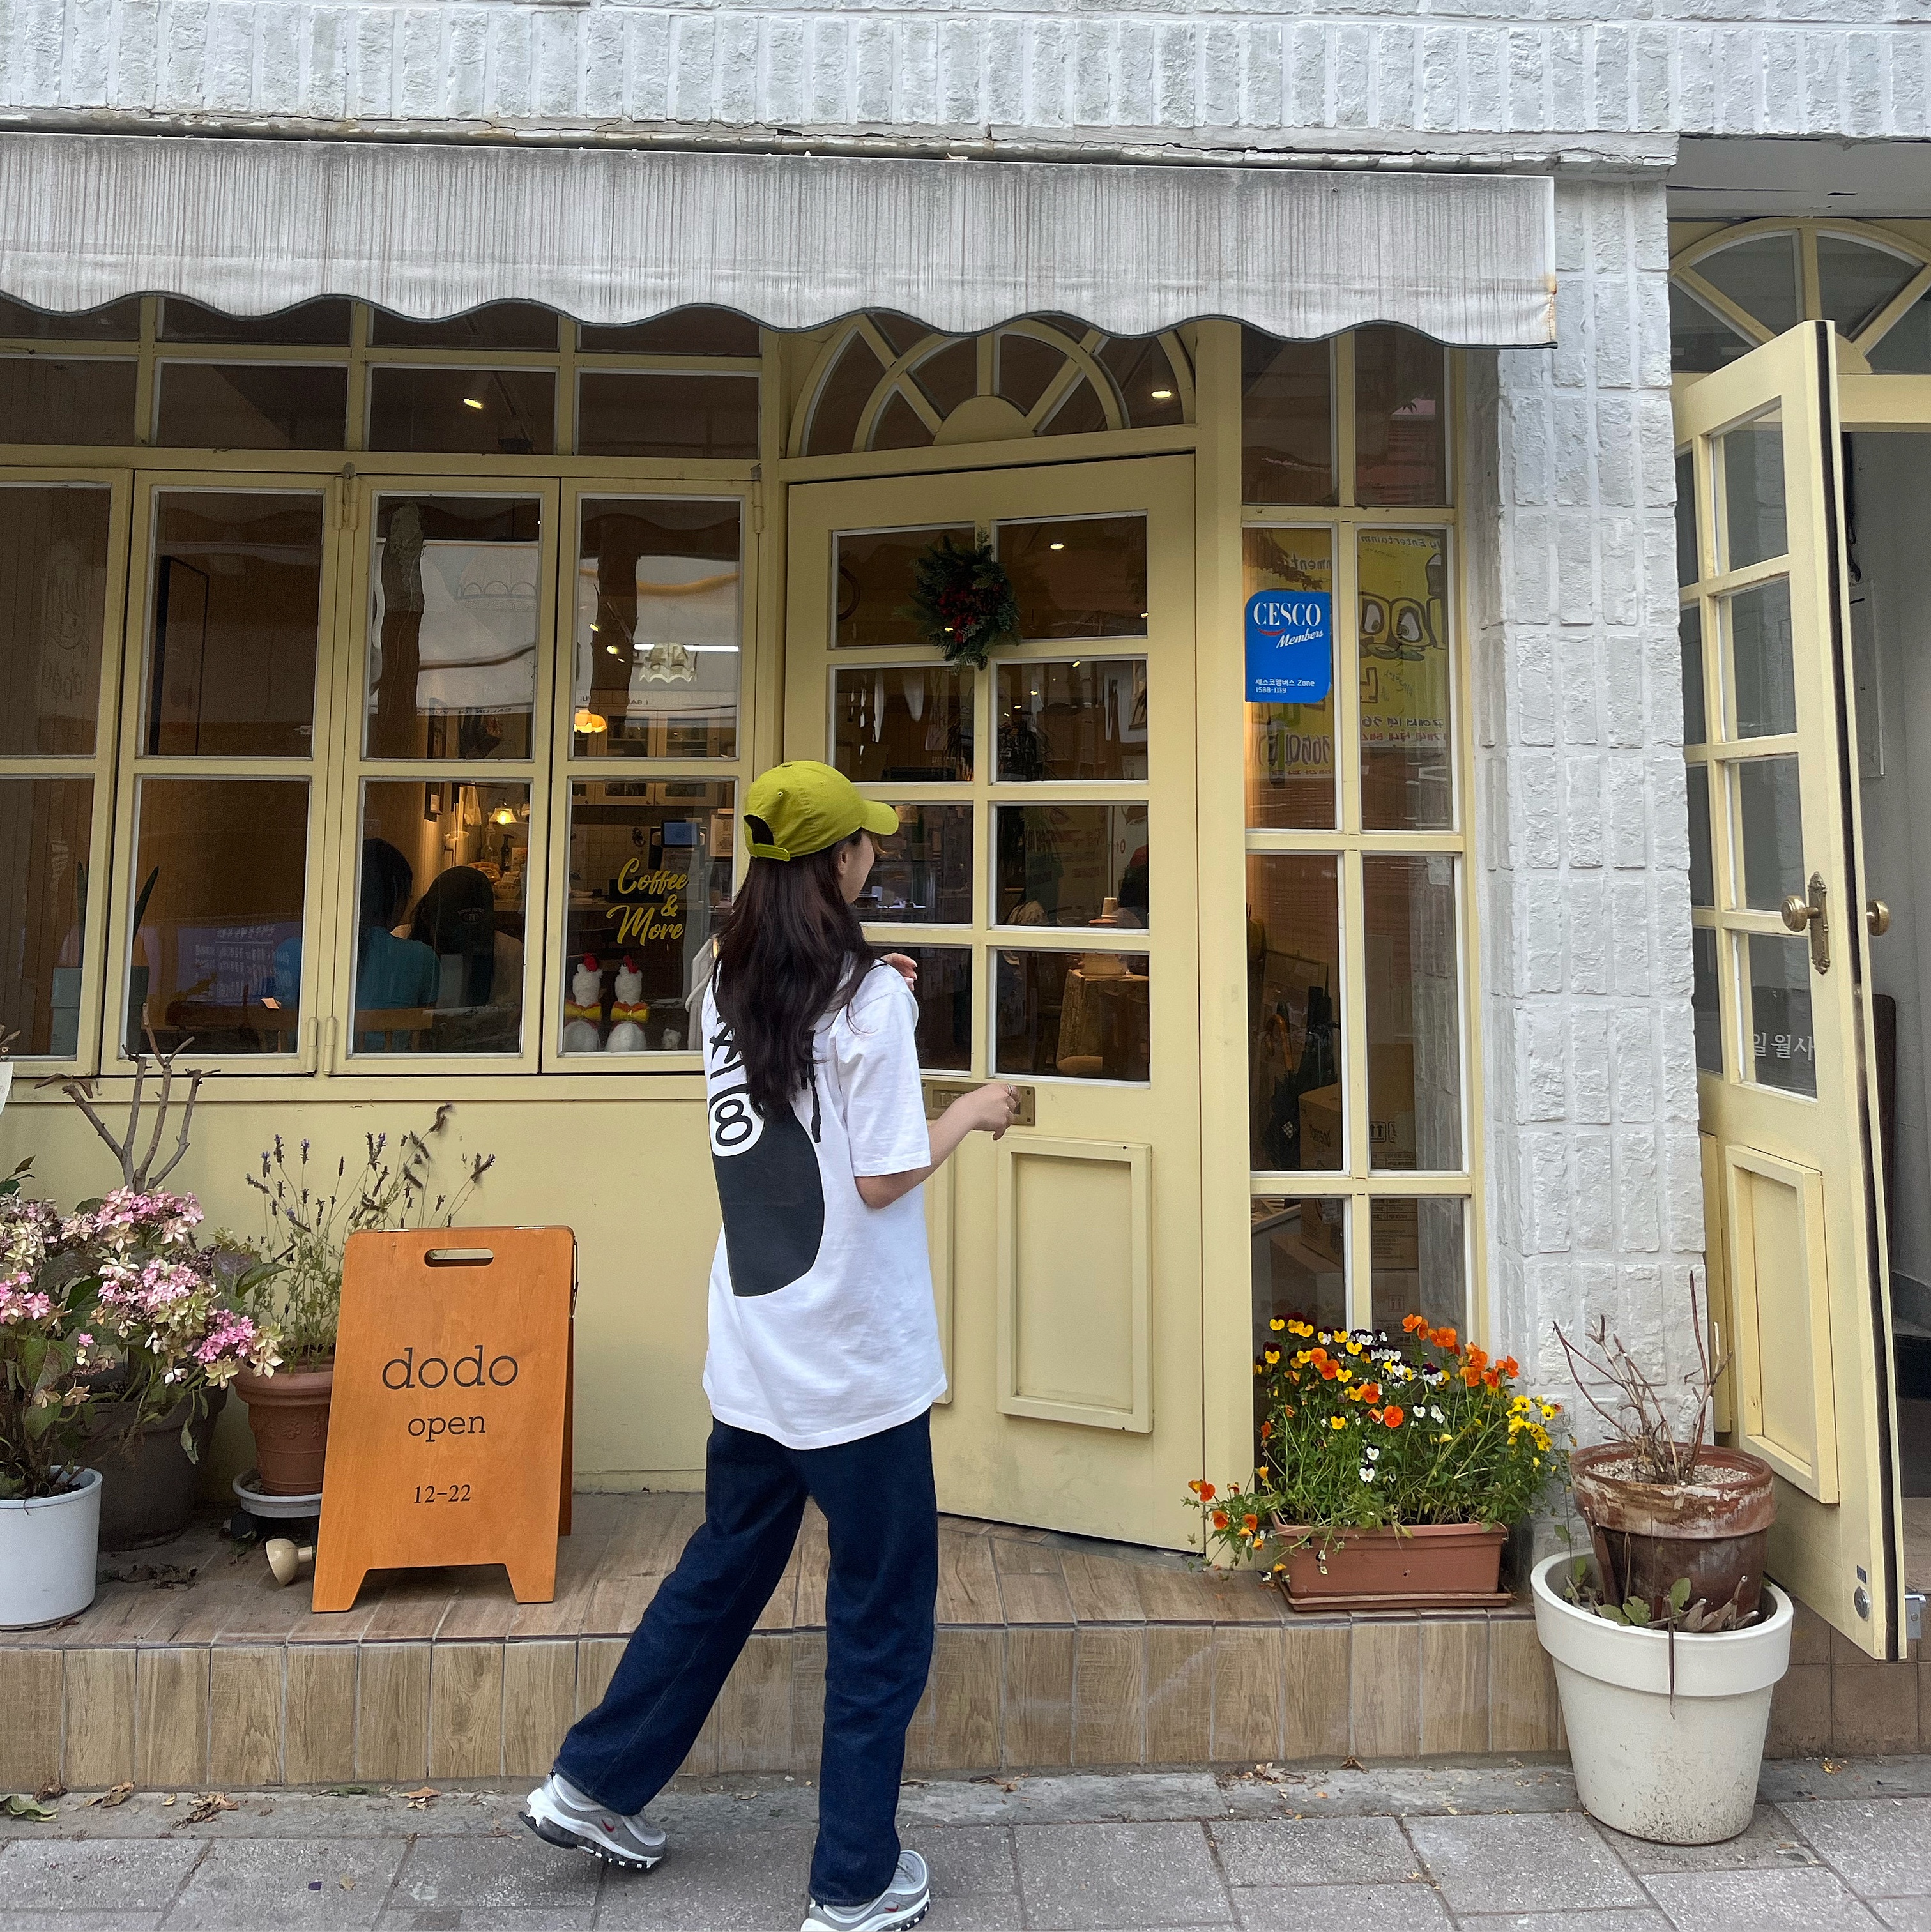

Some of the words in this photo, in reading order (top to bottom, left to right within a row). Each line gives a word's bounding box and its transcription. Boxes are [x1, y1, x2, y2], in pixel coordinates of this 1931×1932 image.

[1253, 602, 1322, 626] CESCO
[1276, 627, 1324, 648] Members
[618, 858, 690, 894] Coffee
[660, 894, 677, 917] &
[606, 905, 684, 946] More
[715, 1099, 753, 1146] 8
[383, 1345, 519, 1390] dodo
[408, 1415, 486, 1443] open
[414, 1484, 471, 1503] 12-22
